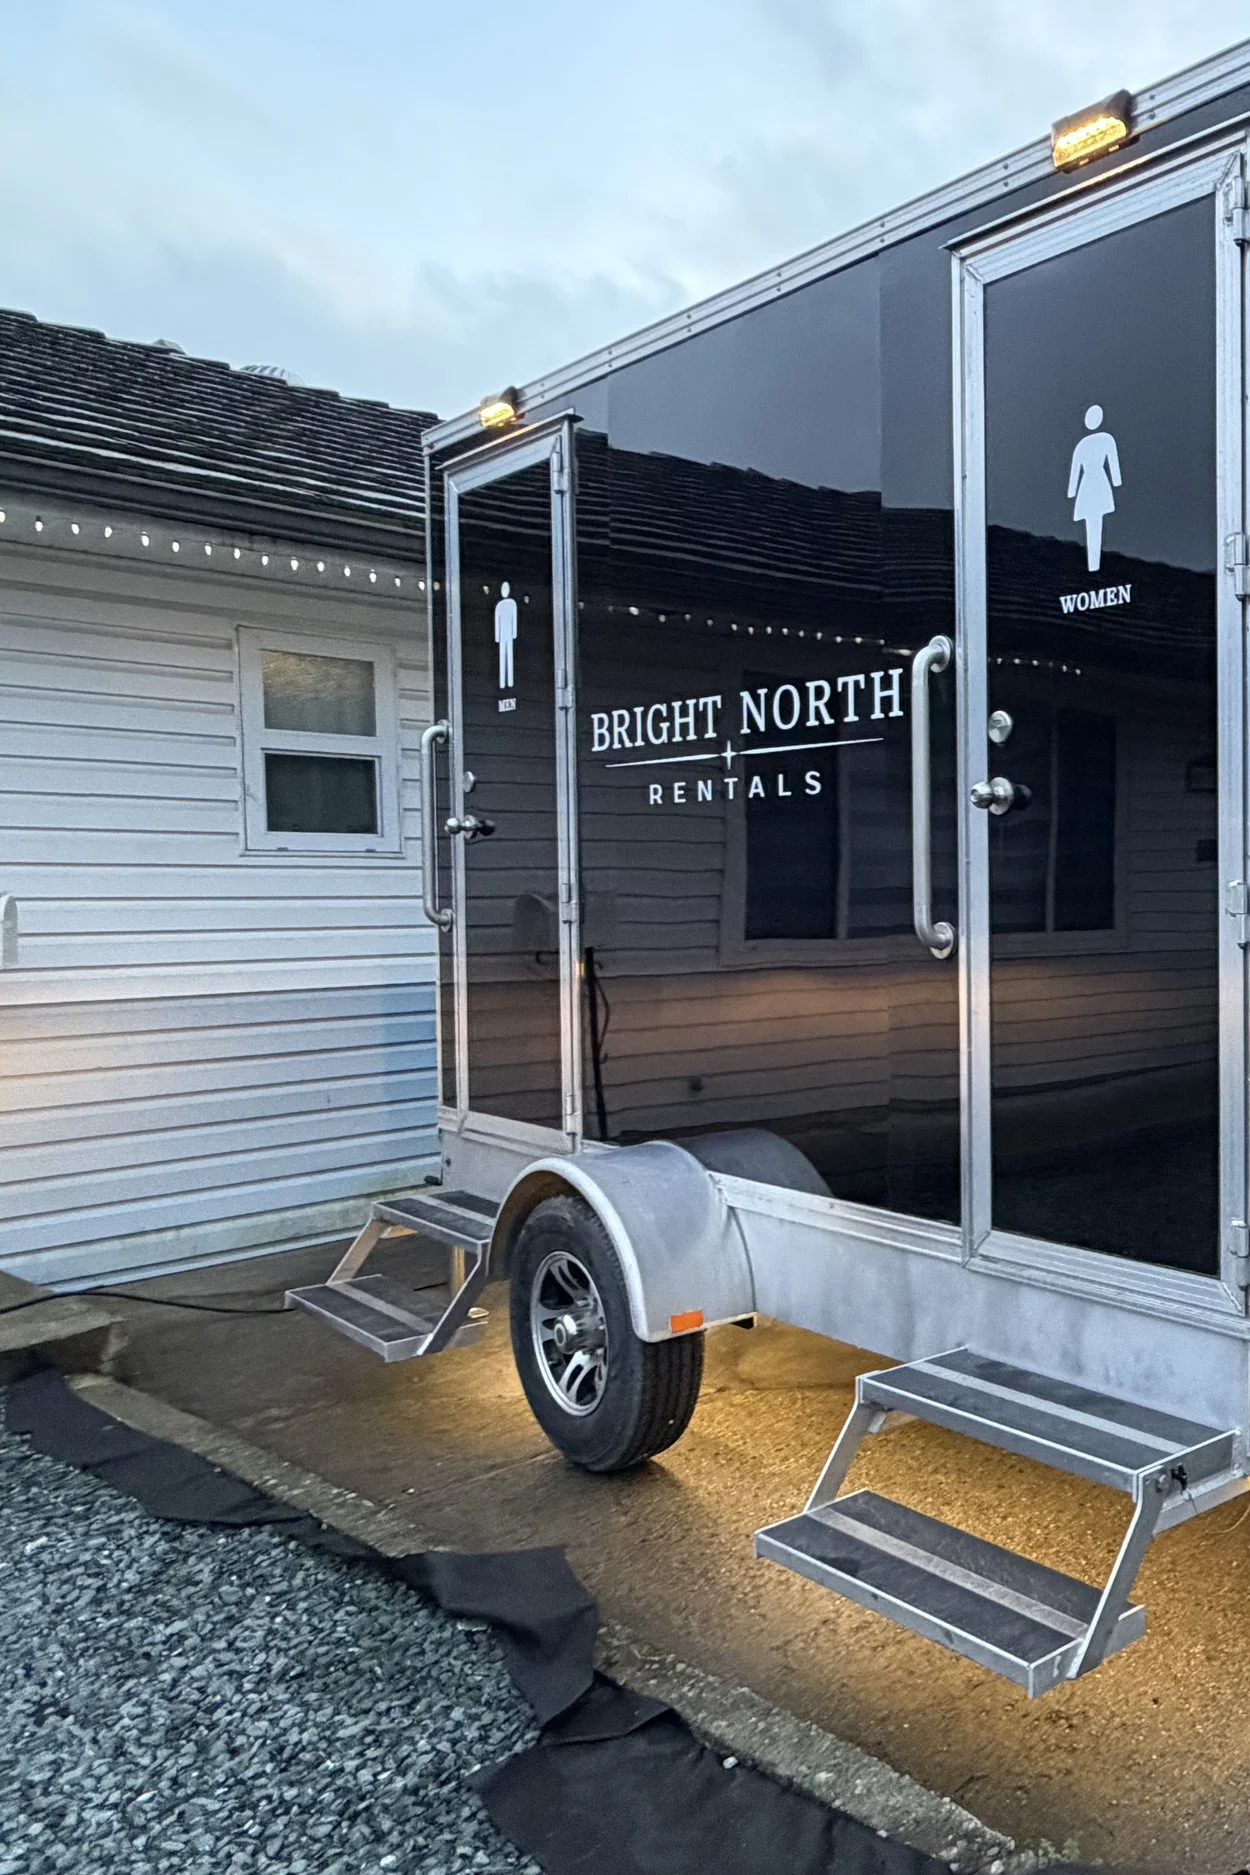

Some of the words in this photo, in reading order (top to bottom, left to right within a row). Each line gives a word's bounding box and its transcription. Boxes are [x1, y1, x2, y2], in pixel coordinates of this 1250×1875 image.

[1059, 585, 1131, 613] WOMEN
[591, 696, 720, 751] BRIGHT
[740, 669, 903, 734] NORTH
[649, 771, 821, 804] RENTALS
